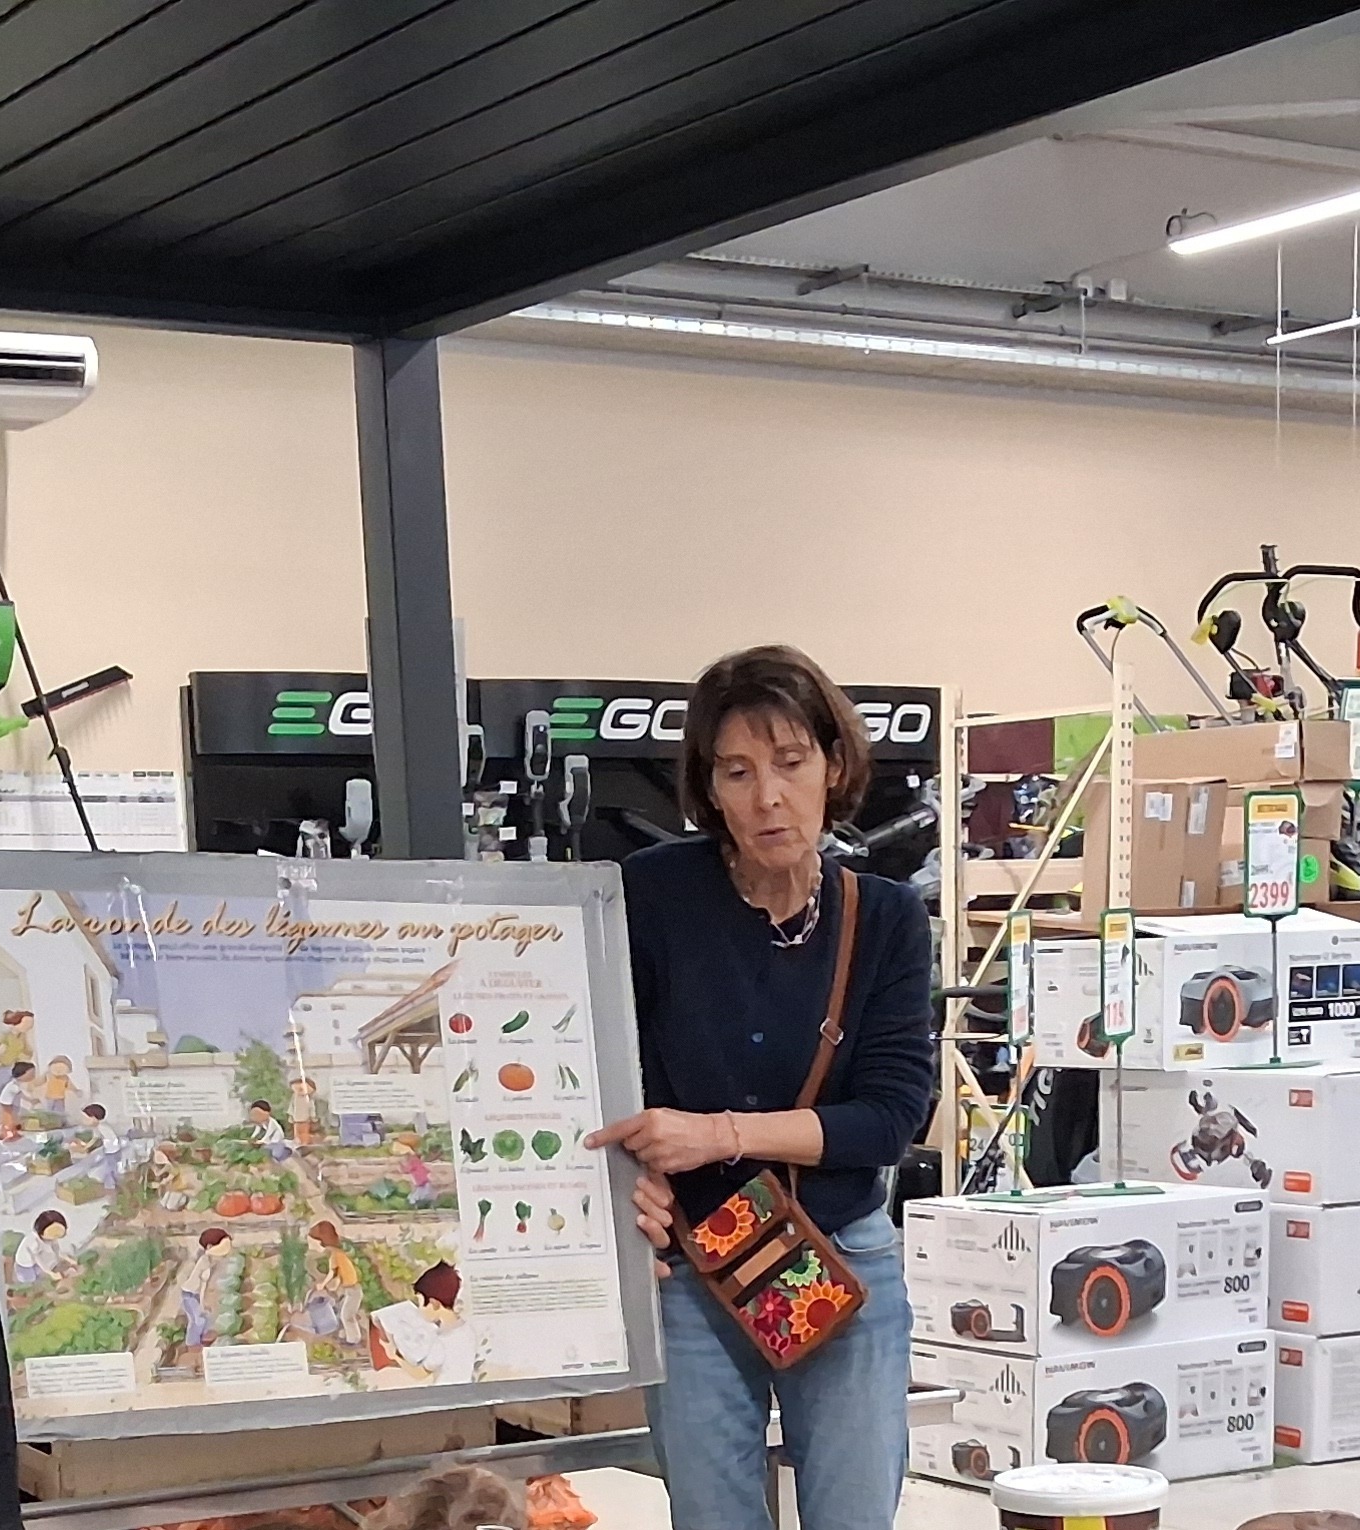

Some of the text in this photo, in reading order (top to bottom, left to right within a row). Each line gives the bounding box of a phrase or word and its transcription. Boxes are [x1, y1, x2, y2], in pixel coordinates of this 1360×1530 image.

[1249, 881, 1289, 909] 2399
[11, 892, 76, 937] La
[201, 901, 258, 938] des
[264, 901, 390, 955] légumes
[397, 919, 444, 941] au
[448, 912, 565, 958] potager
[1223, 1274, 1251, 1294] 800
[1226, 1413, 1255, 1433] 800
